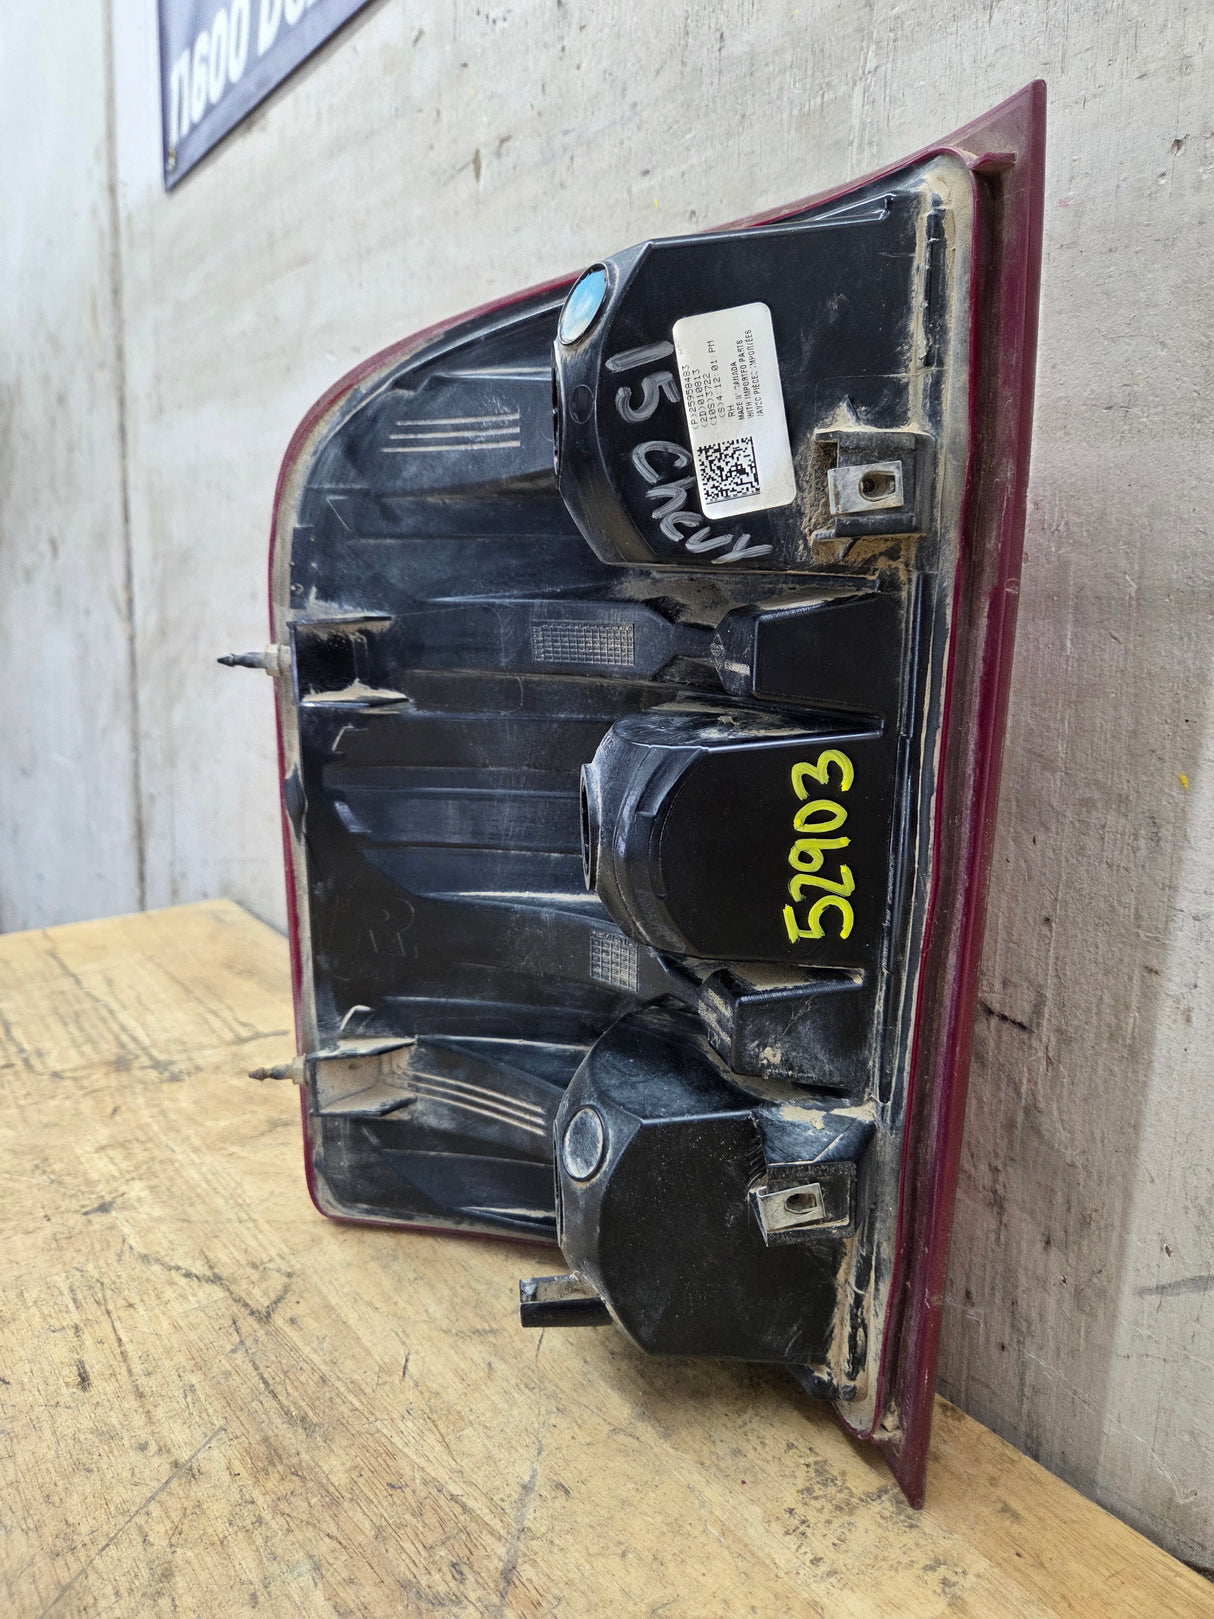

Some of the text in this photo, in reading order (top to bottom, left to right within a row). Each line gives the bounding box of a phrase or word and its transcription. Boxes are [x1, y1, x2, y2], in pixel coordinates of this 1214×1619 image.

[736, 339, 746, 362] PARTS
[605, 340, 681, 423] 15
[682, 364, 698, 429] (P)25958483
[692, 368, 708, 427] (2D)010813
[703, 372, 716, 425] (10S)3722
[728, 405, 735, 417] RH
[783, 749, 855, 944] 52903
